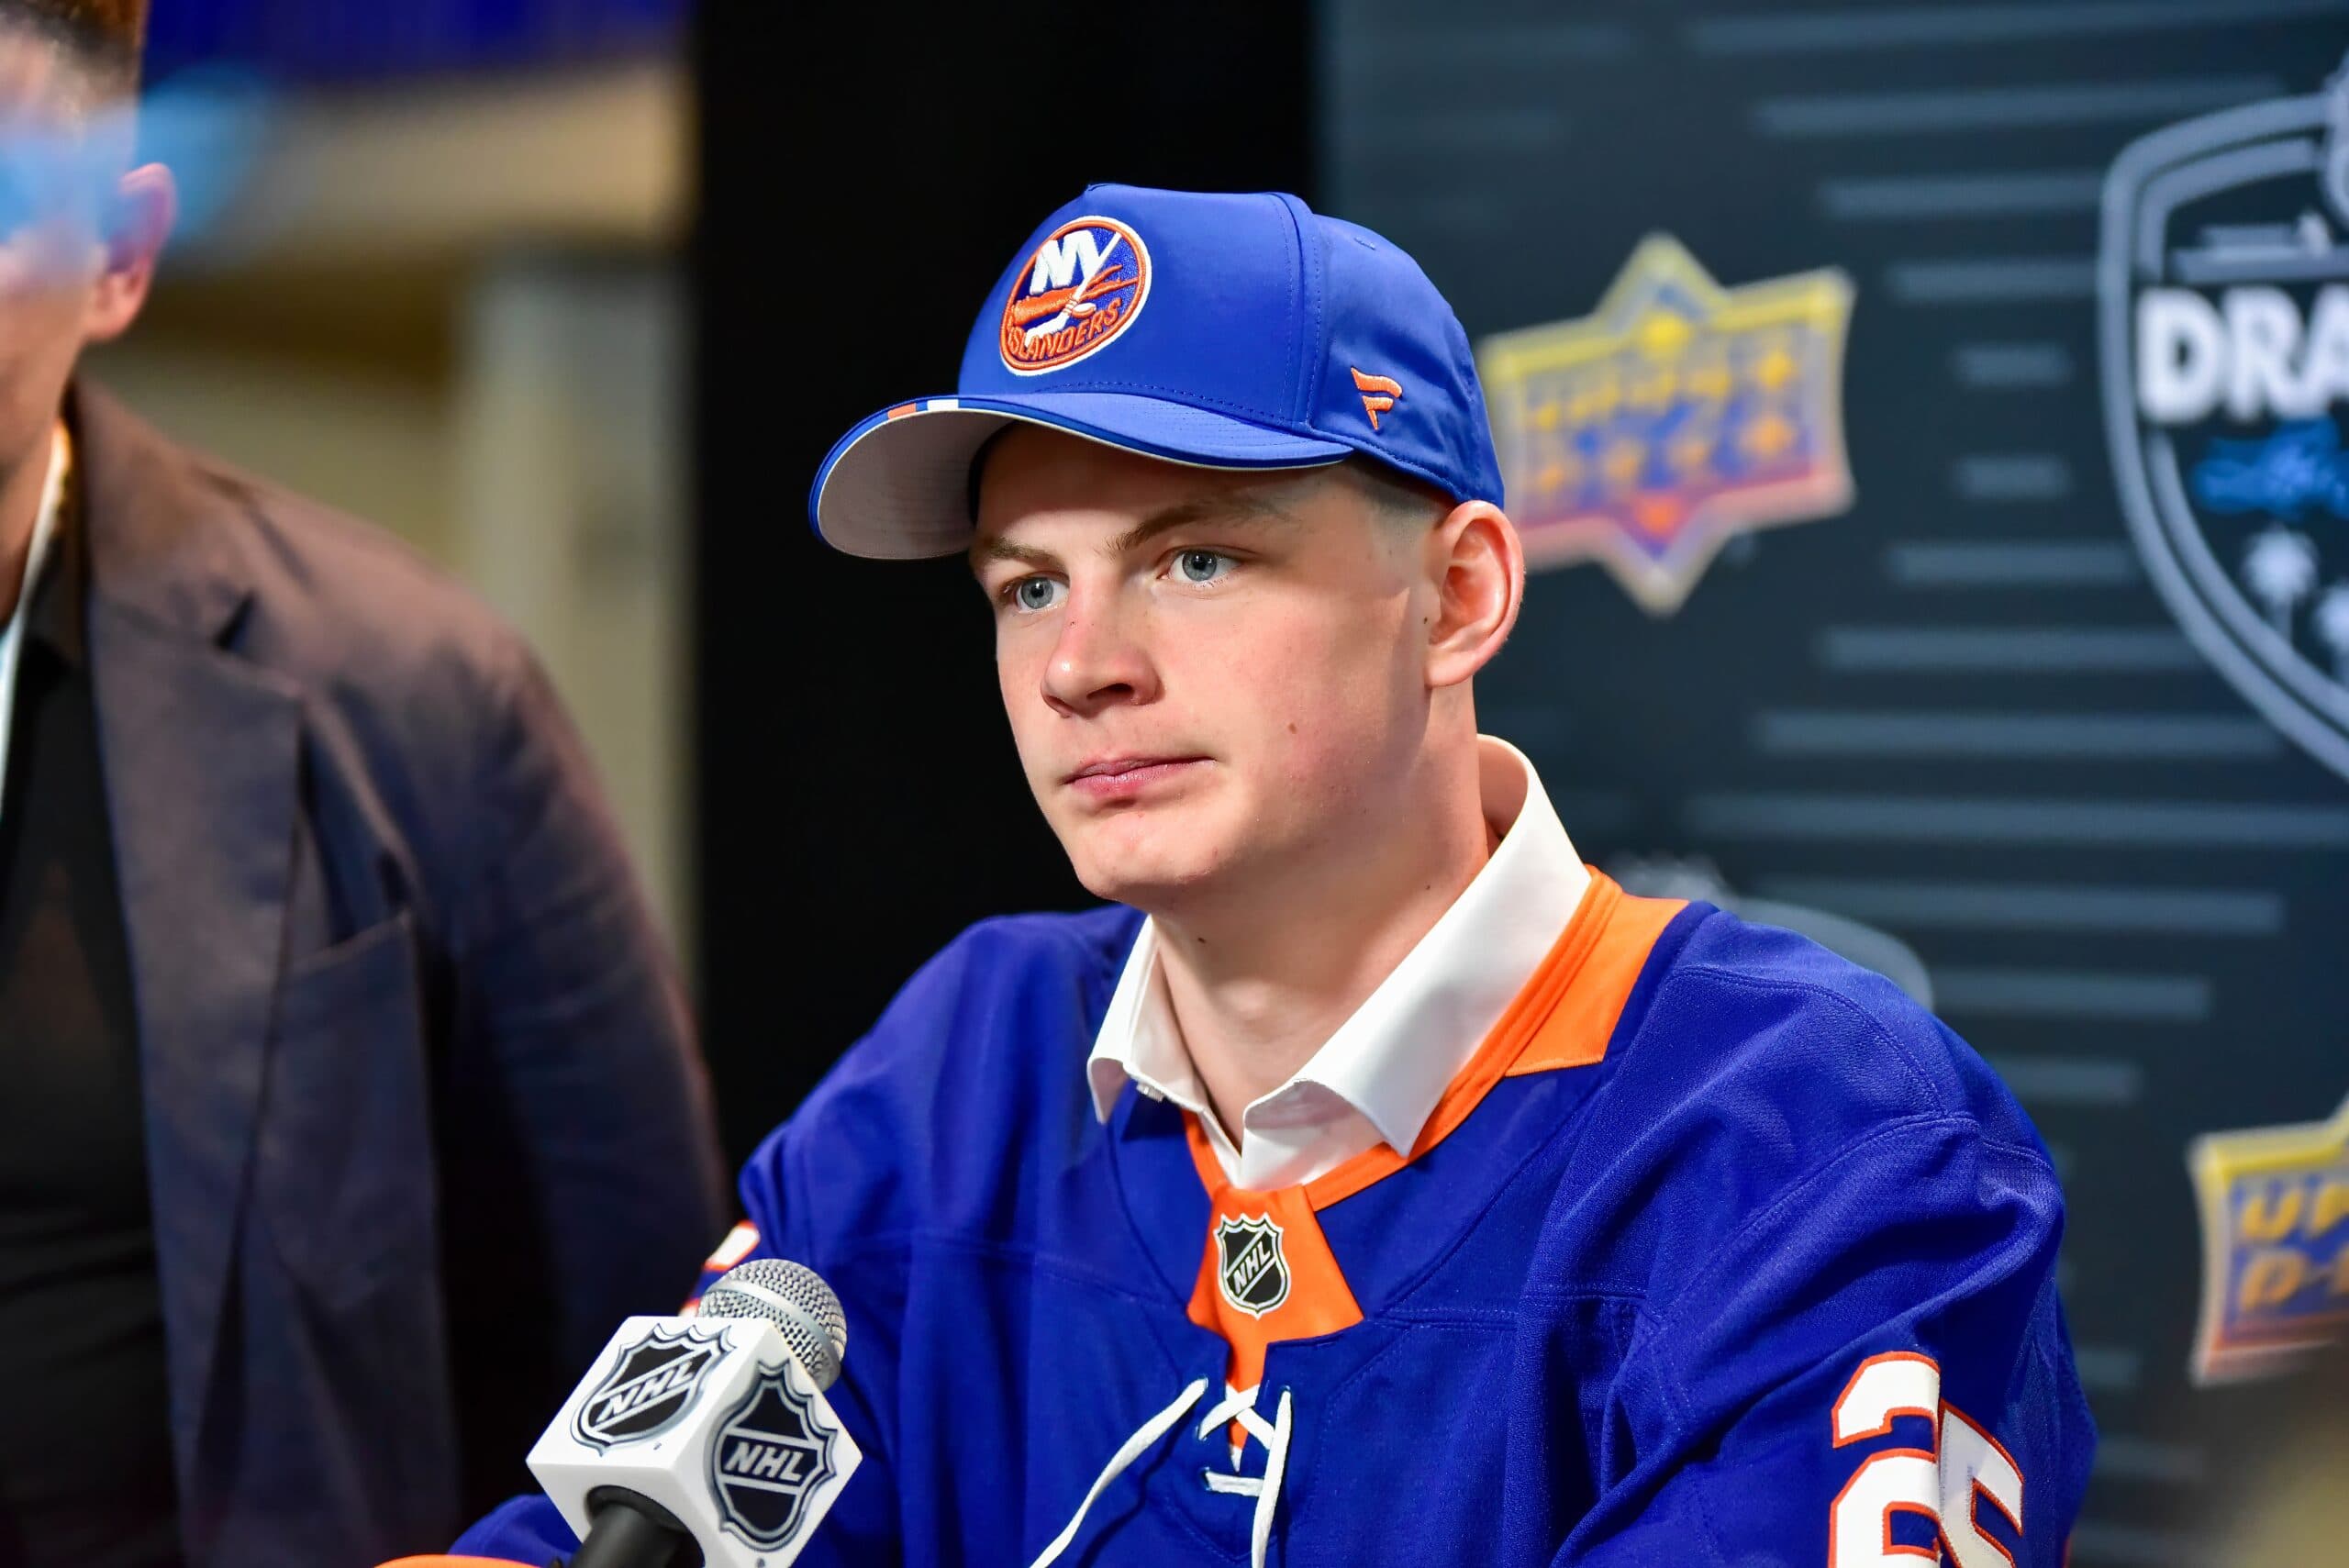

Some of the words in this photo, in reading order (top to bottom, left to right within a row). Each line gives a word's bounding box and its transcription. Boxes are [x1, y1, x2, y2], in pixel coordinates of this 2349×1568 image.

[1030, 229, 1121, 295] NY
[1008, 297, 1122, 361] ISLANDERS
[1233, 1240, 1271, 1295] NHL
[596, 1360, 696, 1424] NHL
[724, 1440, 805, 1483] NHL
